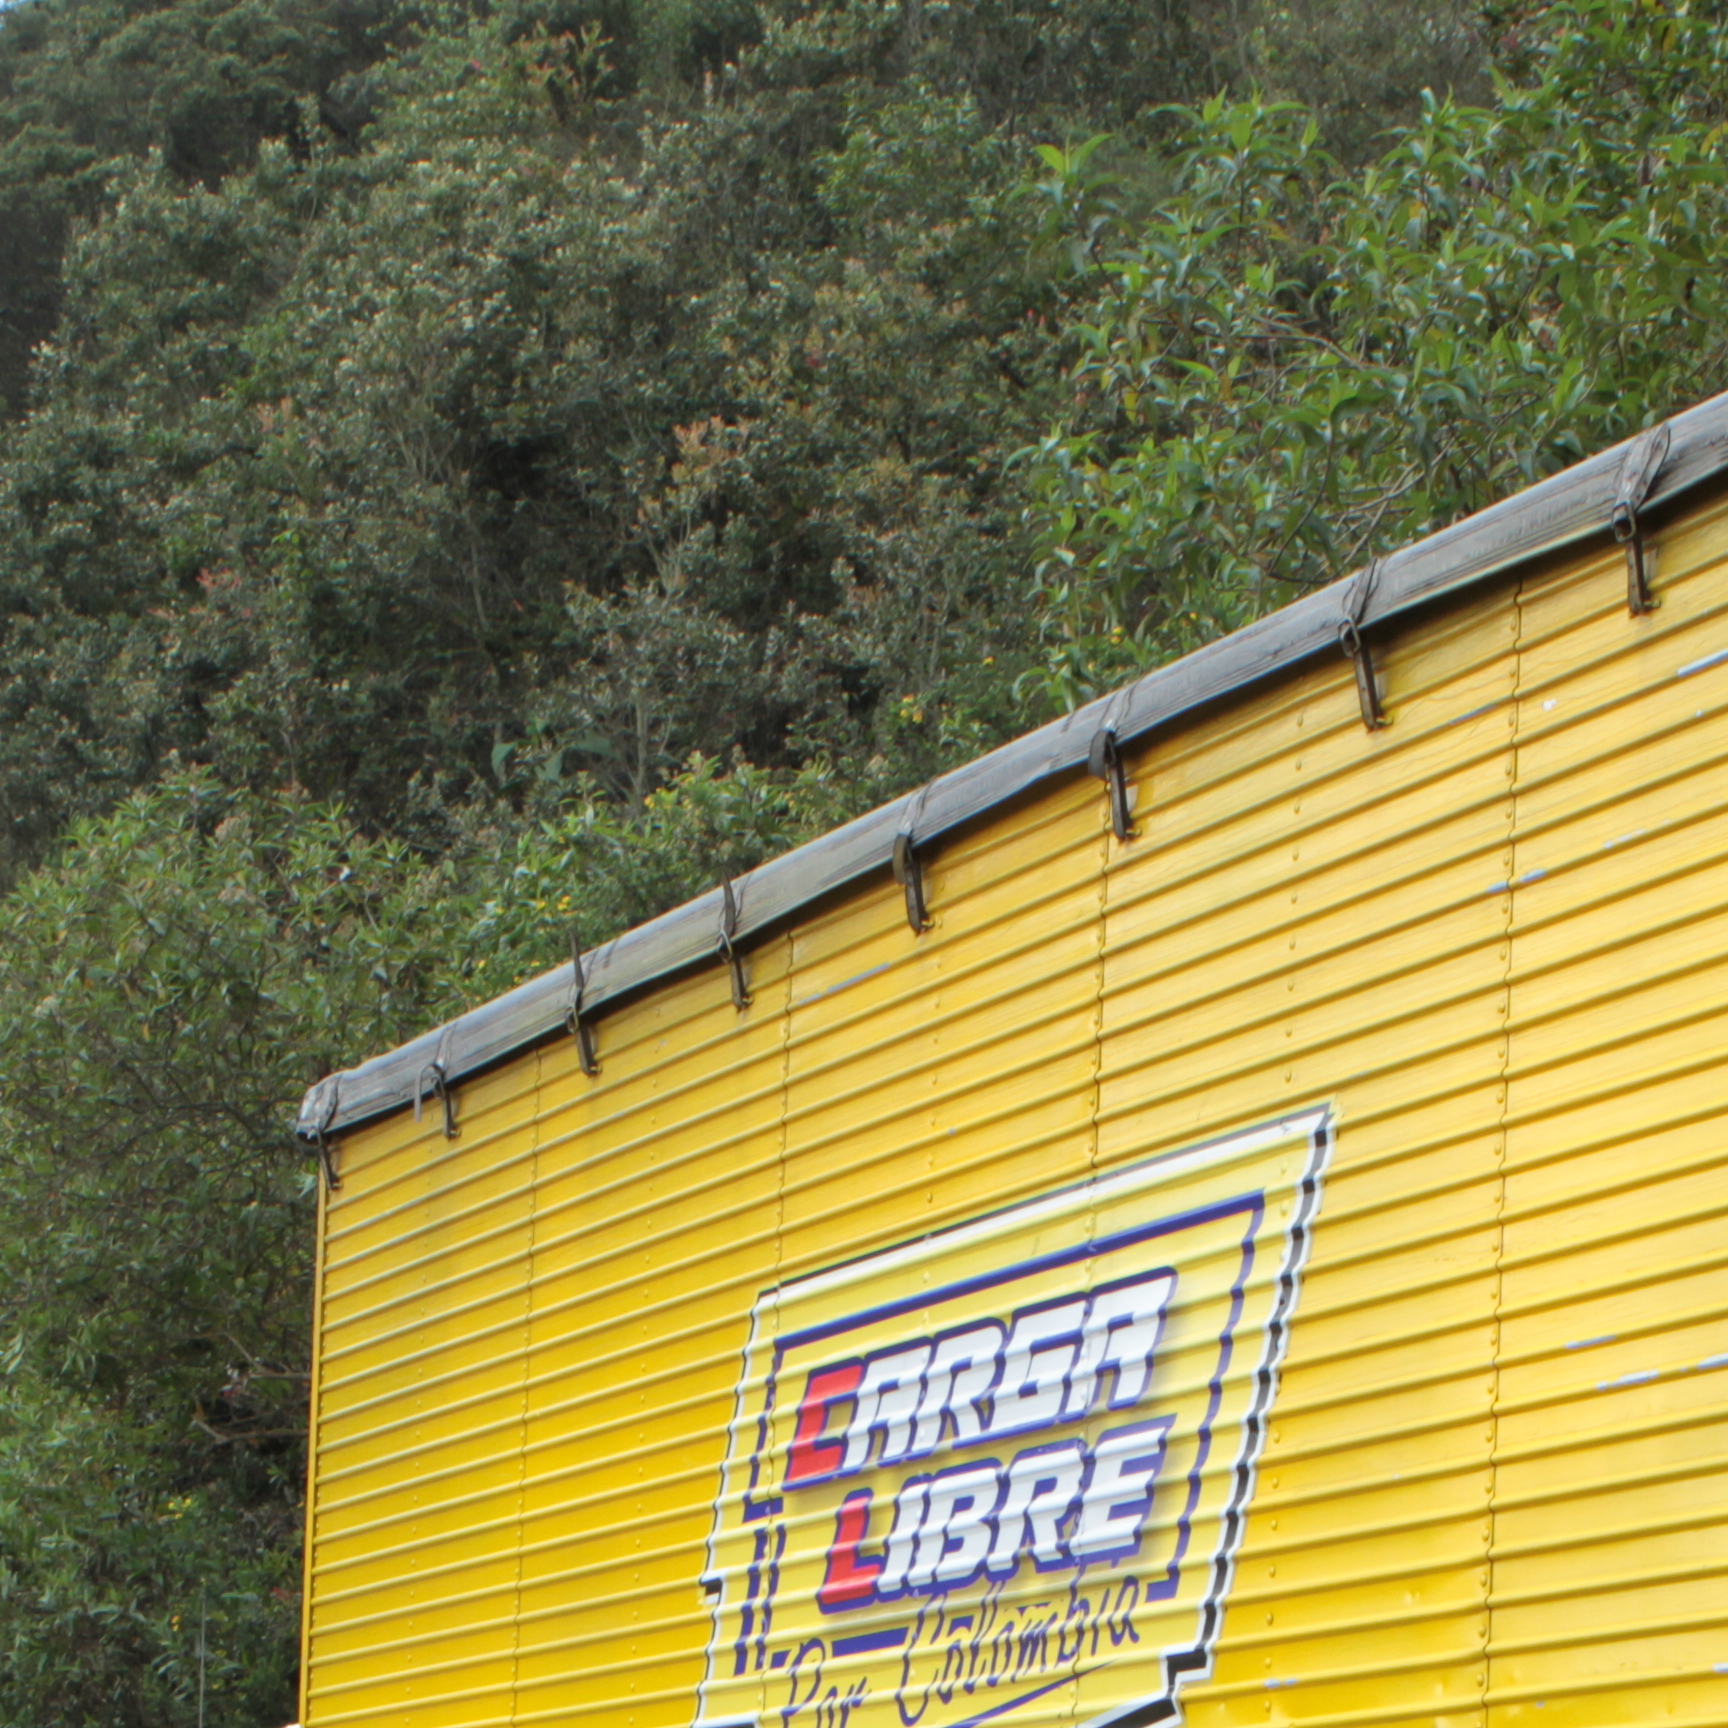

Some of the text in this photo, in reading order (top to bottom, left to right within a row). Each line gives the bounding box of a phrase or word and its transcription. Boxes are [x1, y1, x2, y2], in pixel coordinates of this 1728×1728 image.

[782, 1265, 1178, 1491] CARGA
[817, 1412, 1178, 1615] LIBRE
[895, 1563, 1140, 1727] Colombia
